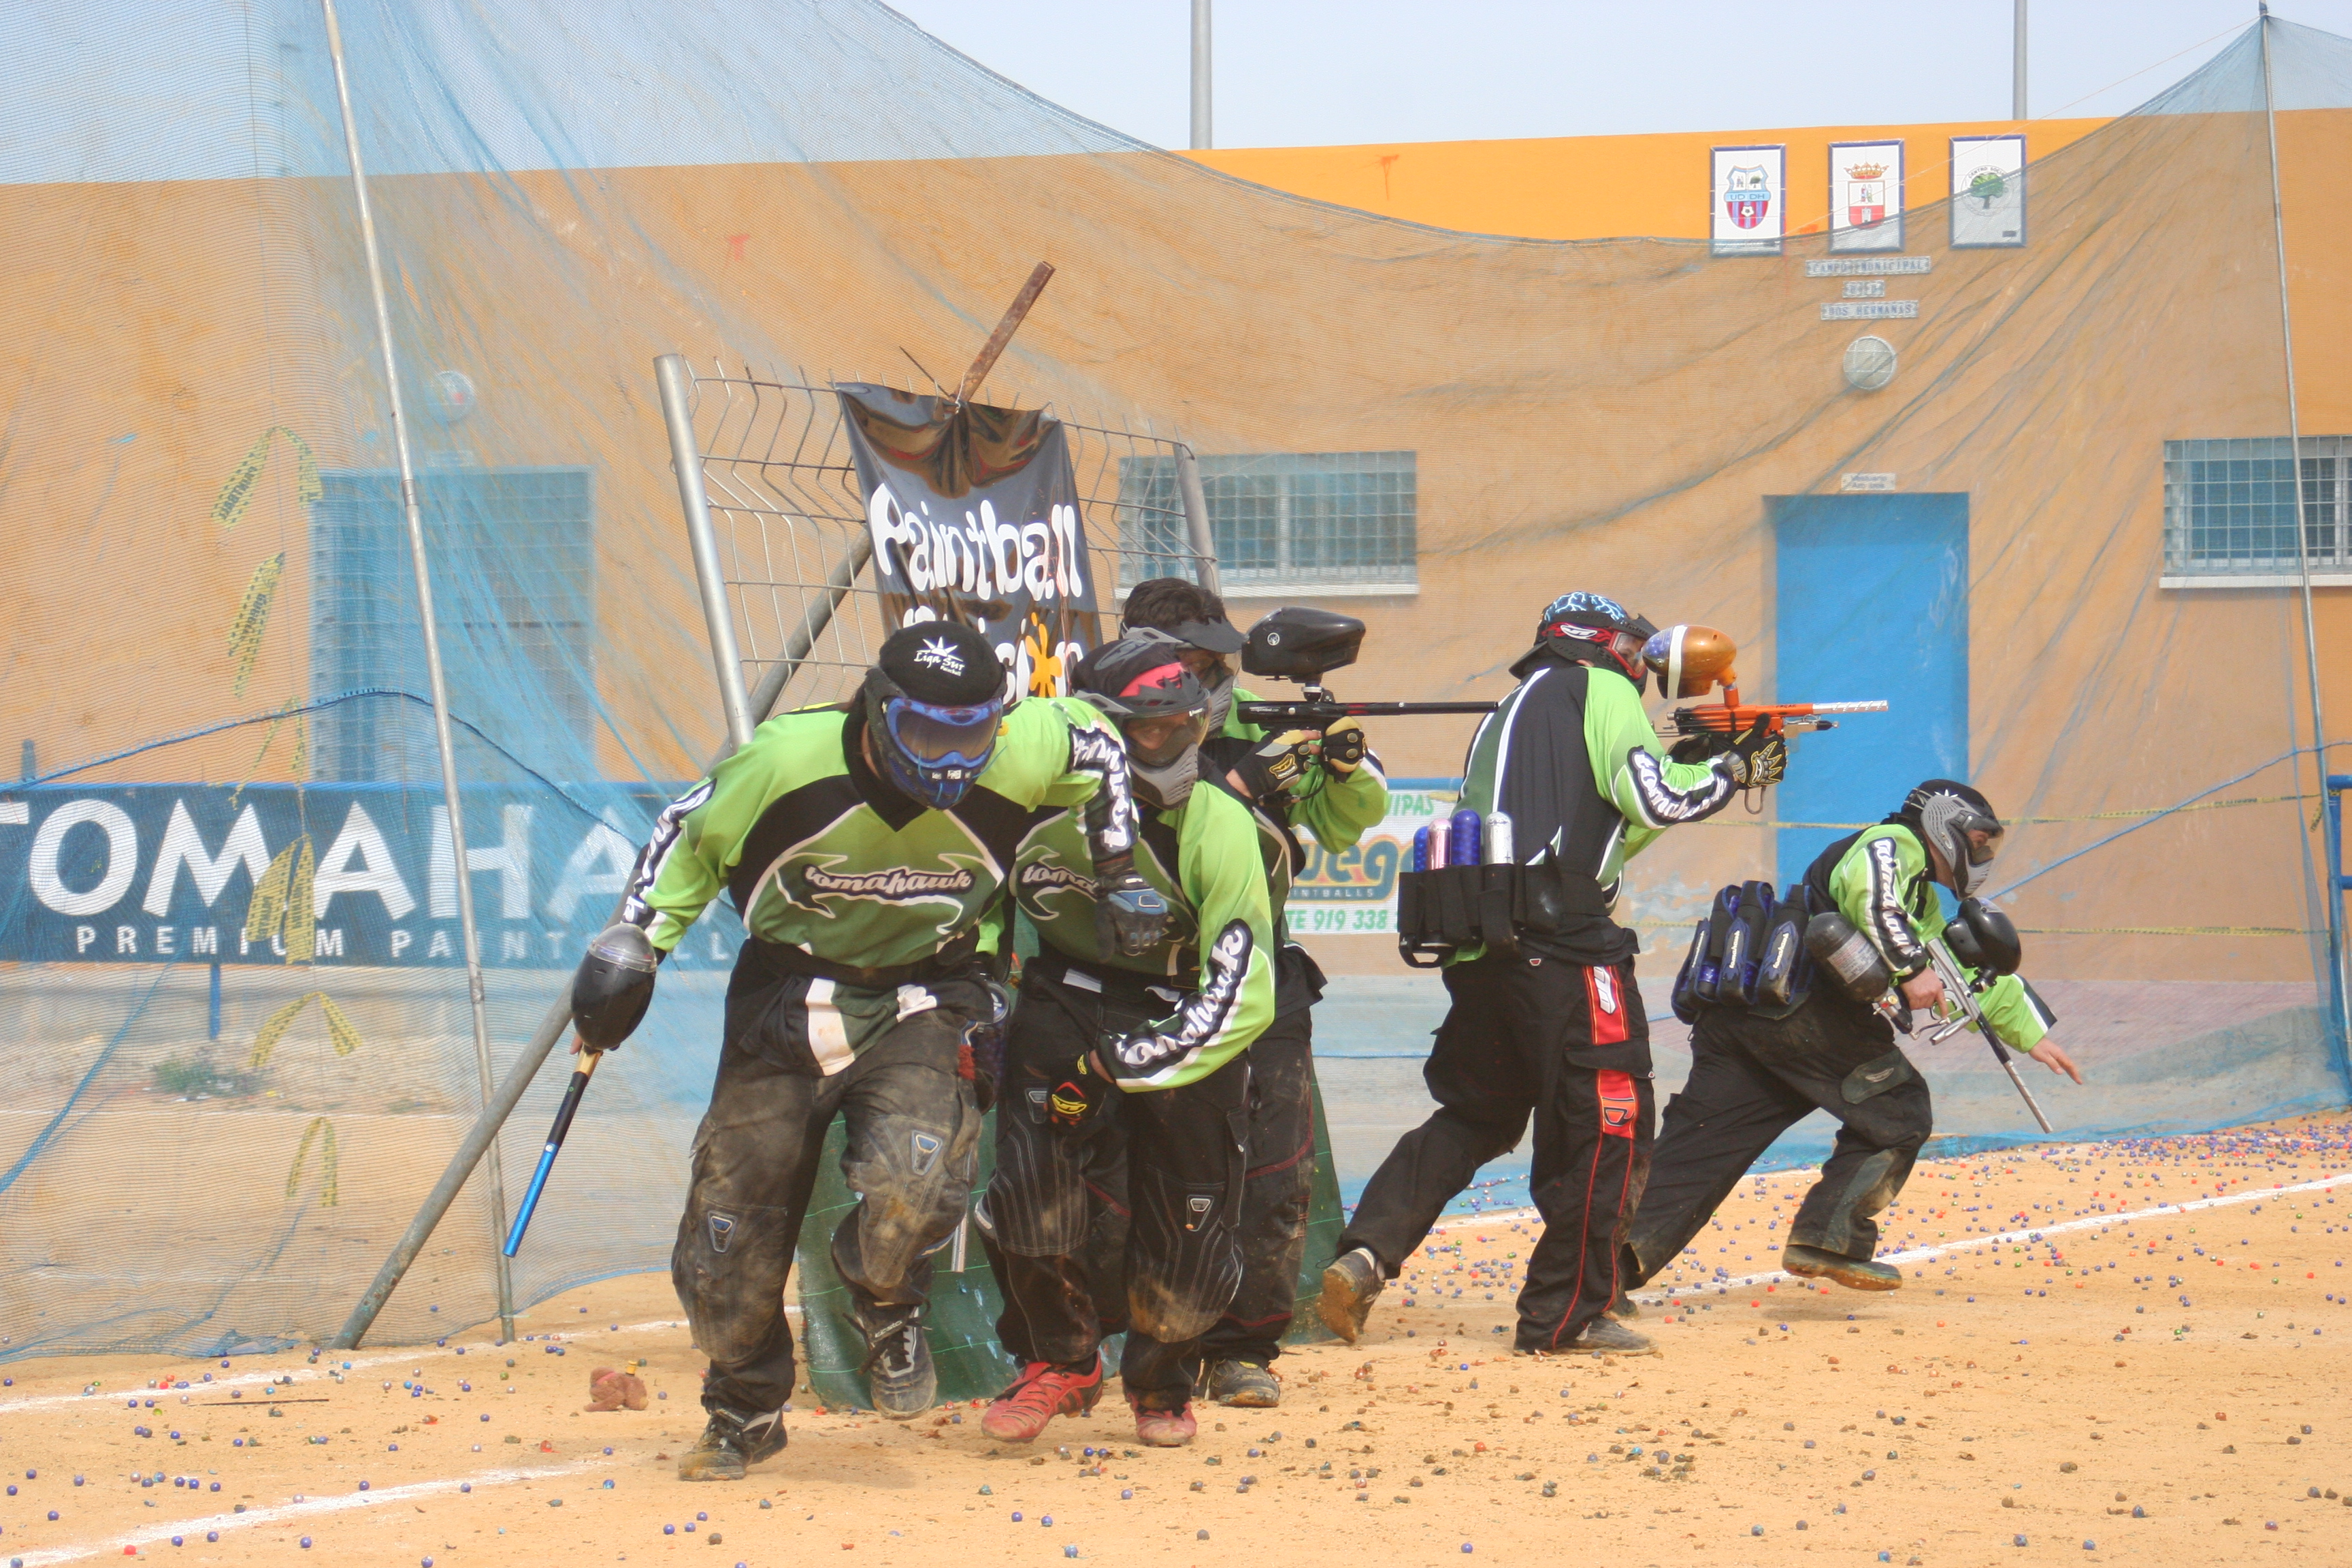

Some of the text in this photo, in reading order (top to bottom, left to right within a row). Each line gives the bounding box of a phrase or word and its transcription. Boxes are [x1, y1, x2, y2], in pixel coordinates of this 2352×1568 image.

[870, 483, 1082, 602] Paintball
[914, 651, 965, 670] Liga Sur
[805, 866, 972, 894] tomahawk
[1294, 888, 1374, 898] INTBALLS
[1314, 909, 1346, 930] 919
[1352, 909, 1388, 930] 338
